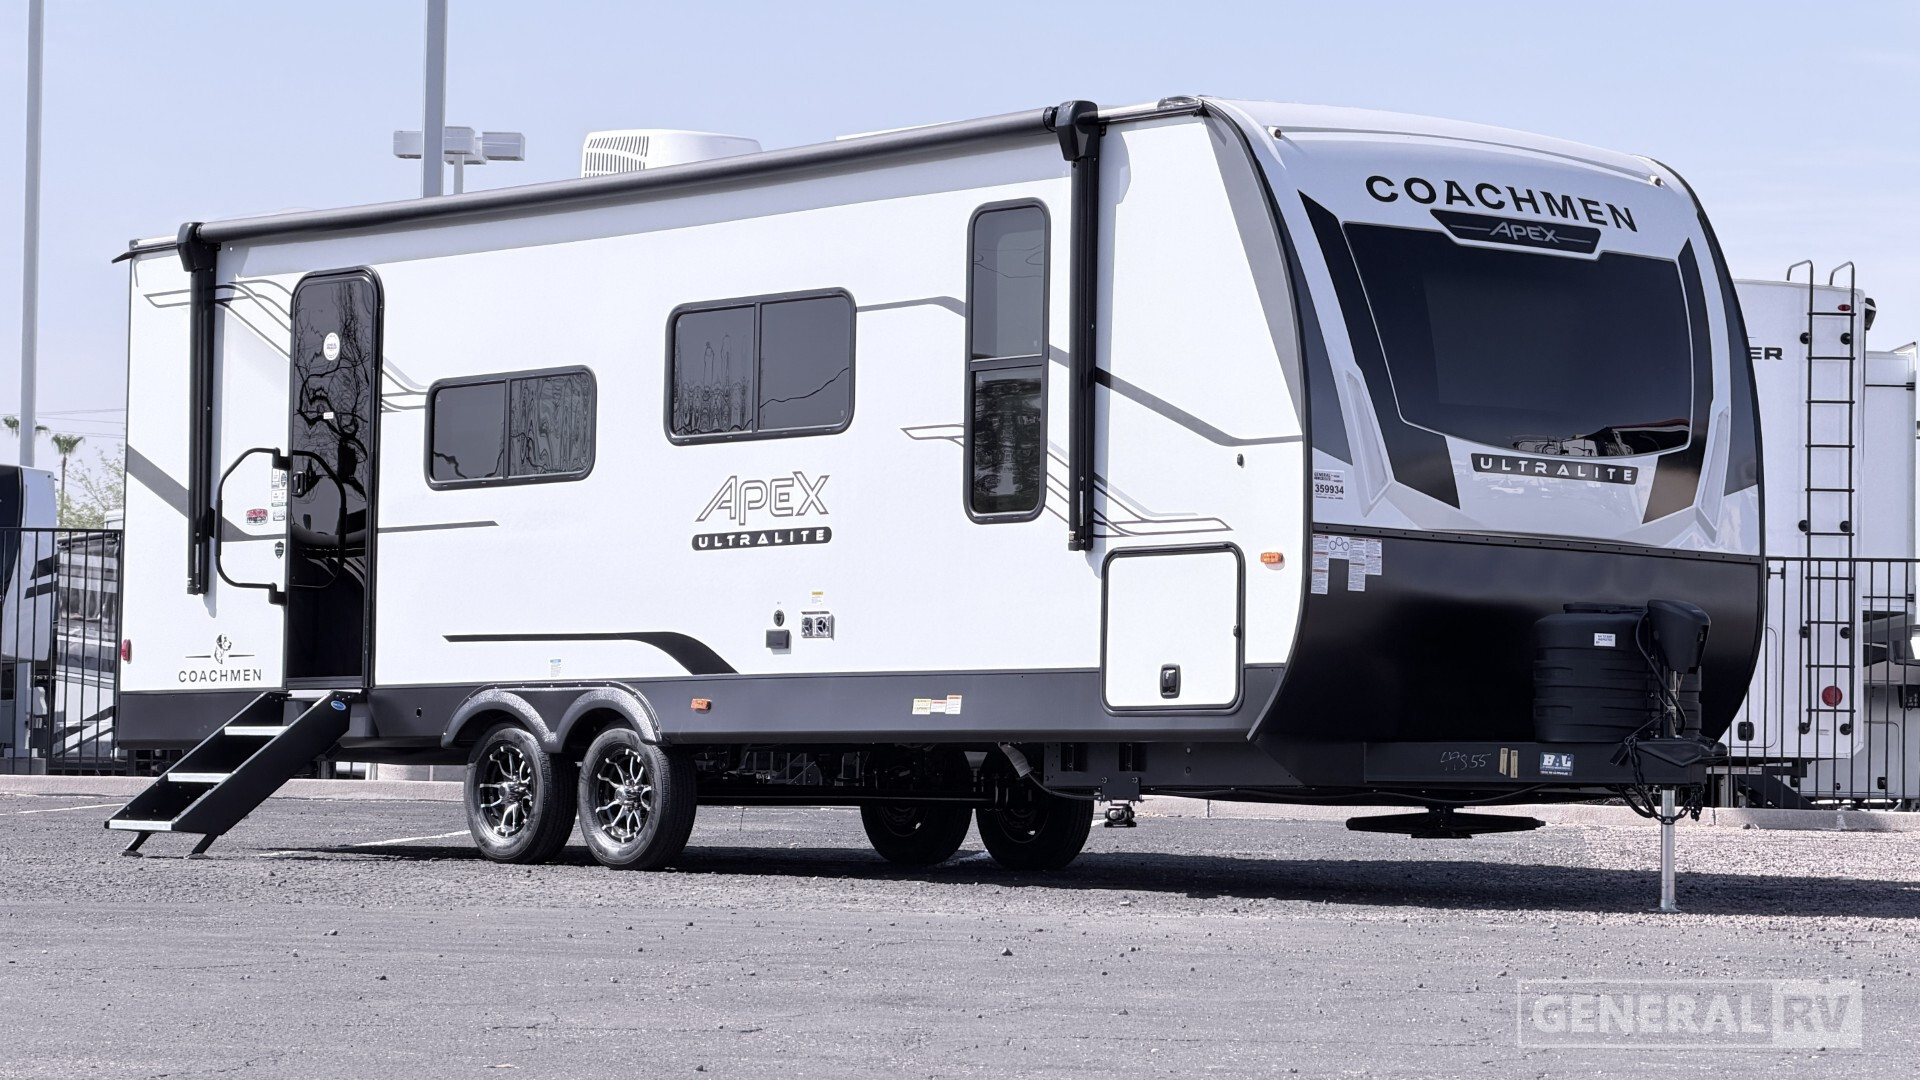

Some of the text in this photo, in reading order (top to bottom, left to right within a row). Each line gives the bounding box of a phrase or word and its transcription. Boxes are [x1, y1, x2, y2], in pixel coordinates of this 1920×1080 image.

[1365, 175, 1638, 233] COACHMEN
[1489, 221, 1560, 244] APEX
[1480, 457, 1633, 482] ULTRALITE
[695, 471, 831, 526] APEX
[1315, 484, 1344, 494] 359934
[698, 529, 825, 548] ULTRALITE
[178, 669, 262, 682] COACHMEN
